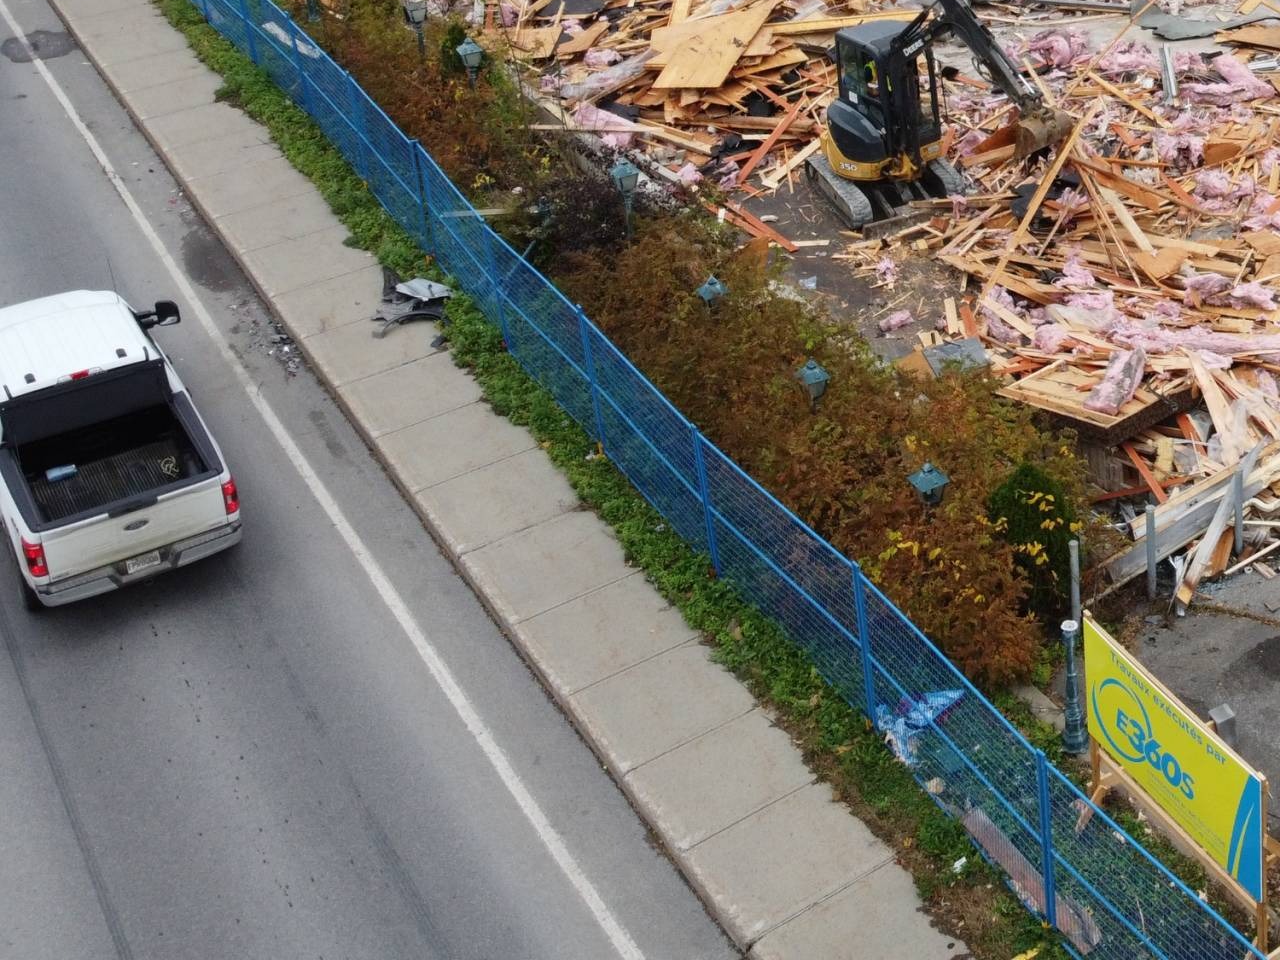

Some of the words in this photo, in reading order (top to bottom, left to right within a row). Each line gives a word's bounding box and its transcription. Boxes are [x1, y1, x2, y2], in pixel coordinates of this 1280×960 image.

[902, 38, 924, 57] DEERE
[1110, 649, 1151, 697] Travaux
[1153, 694, 1204, 746] exécutés
[1205, 743, 1227, 765] par
[1116, 707, 1195, 801] E360S
